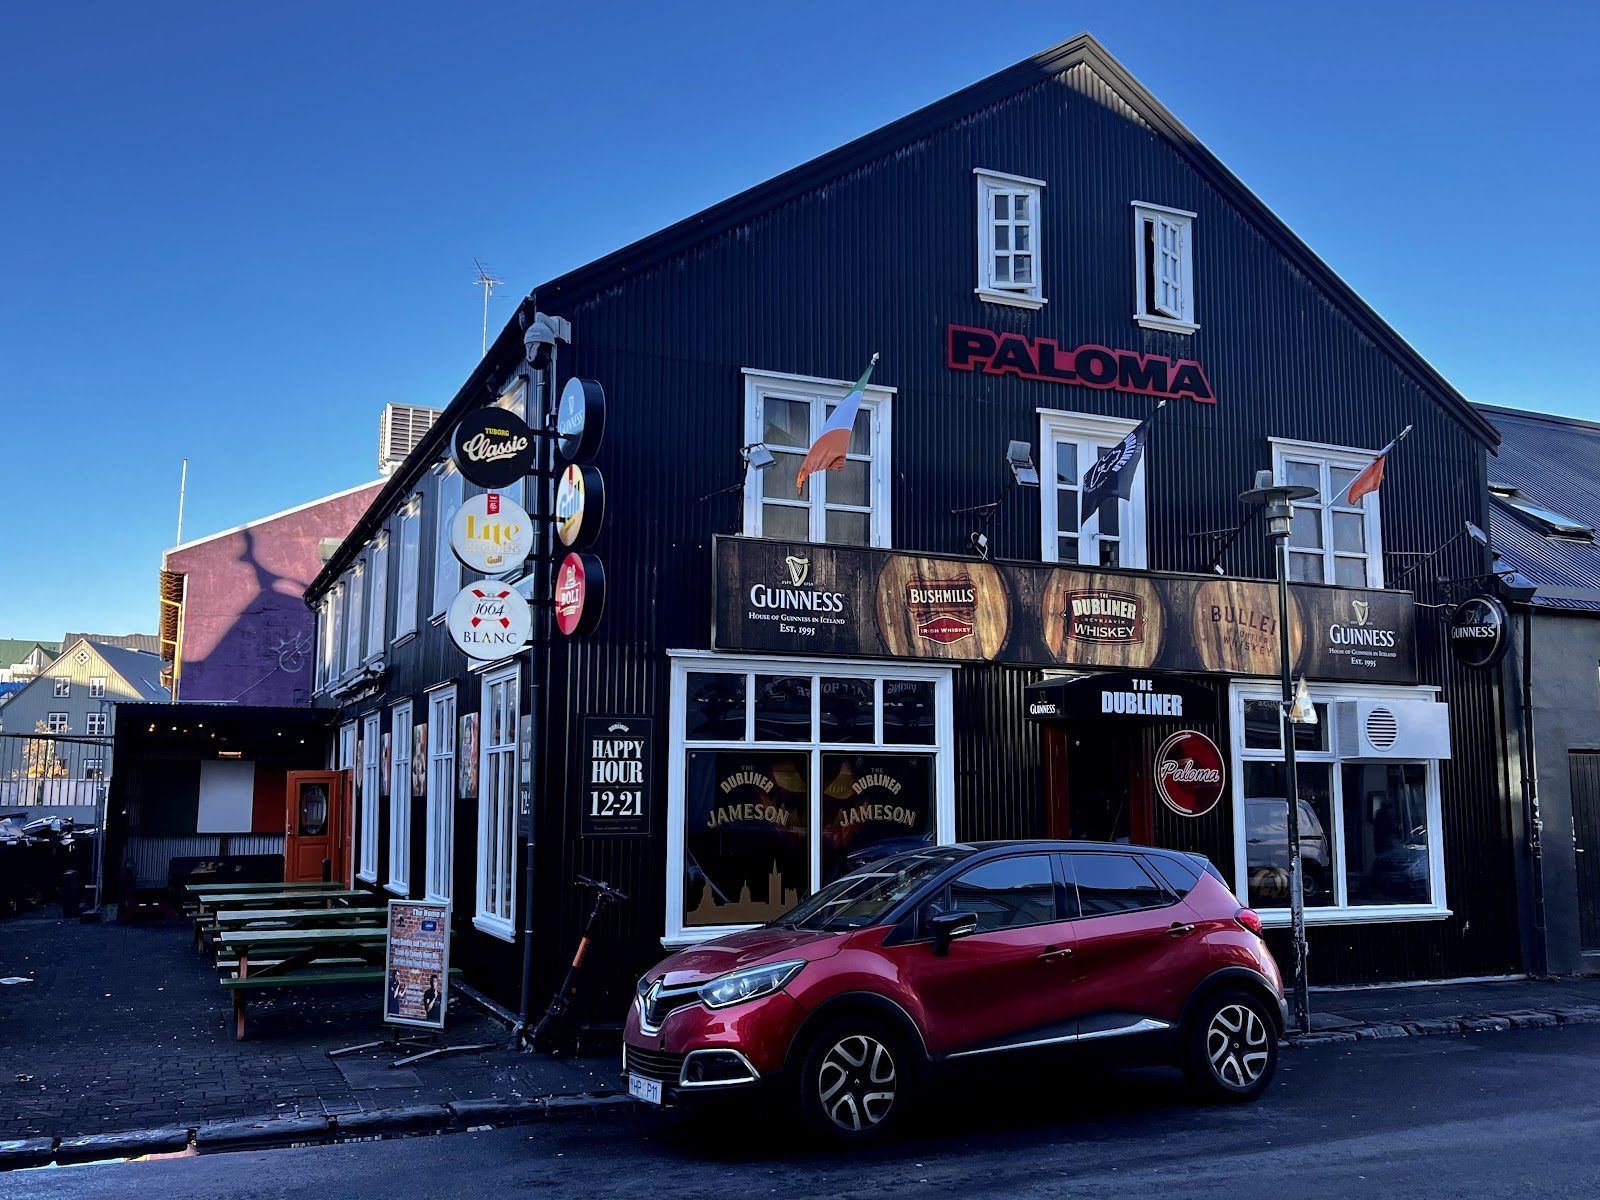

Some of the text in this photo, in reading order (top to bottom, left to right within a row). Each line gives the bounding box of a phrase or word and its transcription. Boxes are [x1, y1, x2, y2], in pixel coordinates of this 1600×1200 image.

[951, 327, 1215, 400] PALOMA
[485, 427, 510, 437] TUBORG
[462, 433, 529, 462] Classic
[467, 515, 520, 545] Lite
[750, 584, 844, 612] GUINNESS
[910, 588, 975, 604] BUSHMILLS
[475, 602, 505, 616] 1664
[748, 612, 771, 620] HOUSE
[780, 614, 811, 623] GUINNESS
[820, 617, 846, 625] ICELAND
[1071, 599, 1137, 620] DUBLINER
[463, 631, 517, 644] BLANC
[780, 623, 816, 636] EST. 1995
[1074, 623, 1136, 638] WHISKEY
[1330, 624, 1395, 647] GUINNESS
[1451, 626, 1496, 639] GUINNESS
[1364, 660, 1377, 668] 1995
[1131, 679, 1153, 691] THE
[1030, 703, 1056, 714] GUINNESS
[1101, 691, 1183, 716] DUBLINER
[591, 740, 644, 758] HAPPY
[591, 760, 644, 783] HOUR
[1161, 760, 1220, 782] Paloma
[720, 772, 775, 794] DUBLINER
[852, 774, 902, 795] DUBLINER
[590, 791, 643, 816] 12-21
[707, 803, 790, 828] JAMESON
[840, 804, 917, 828] JAMESON
